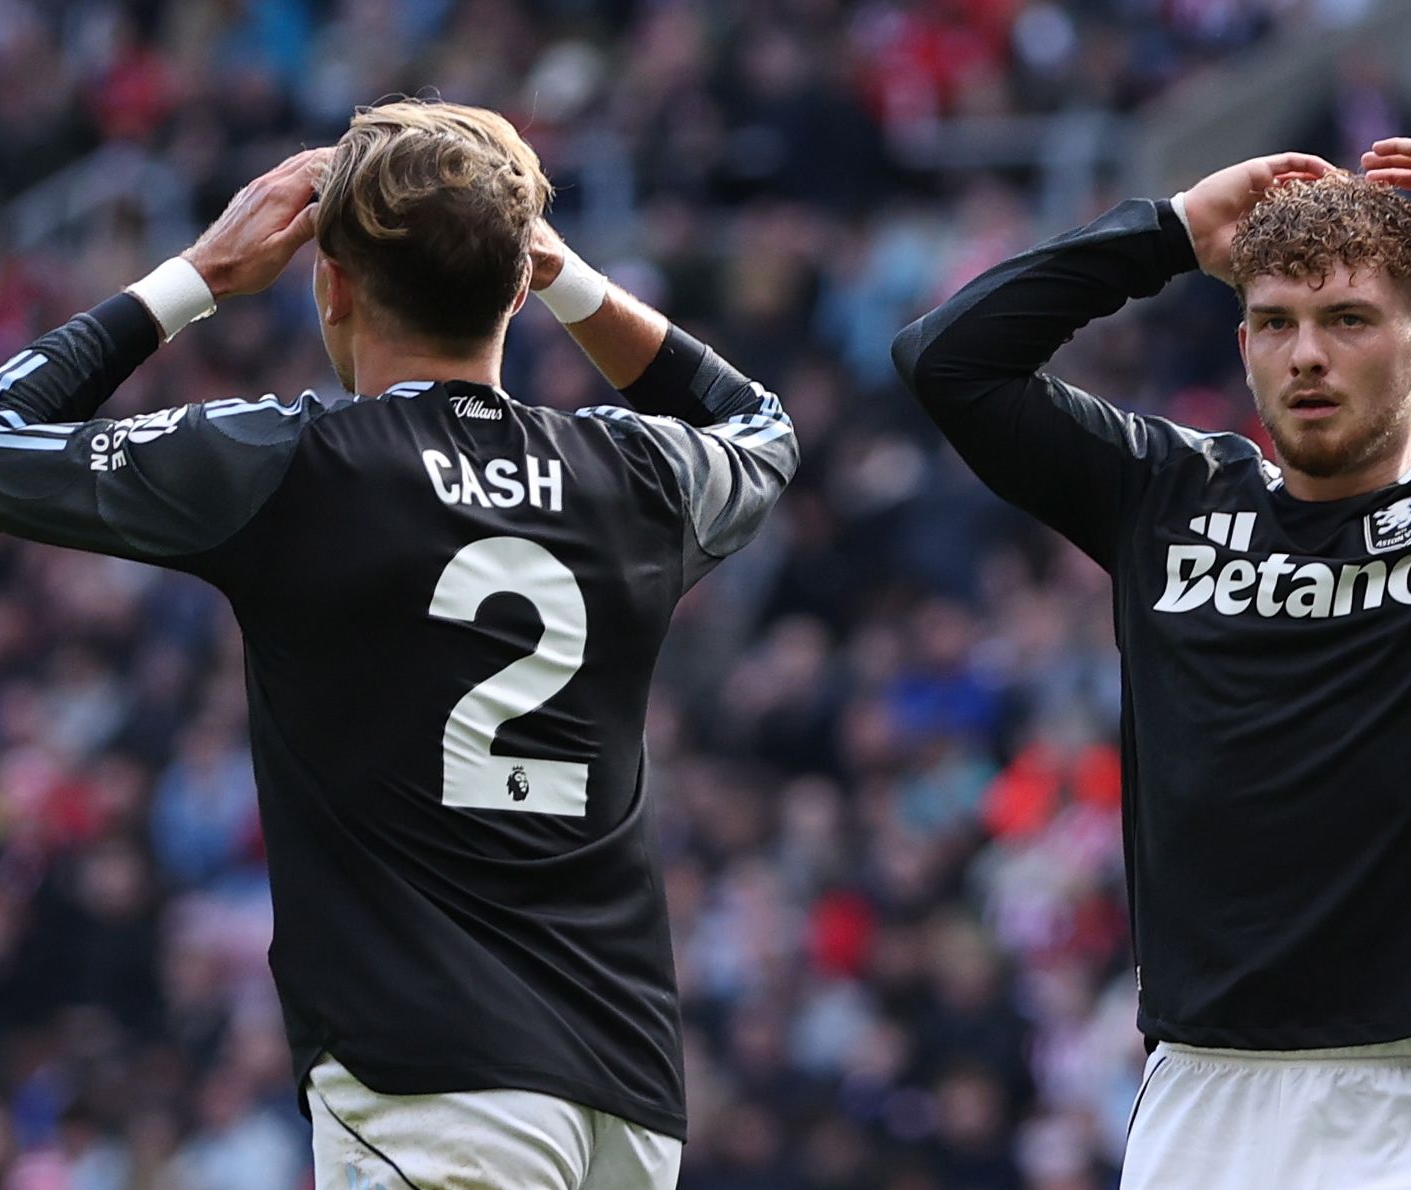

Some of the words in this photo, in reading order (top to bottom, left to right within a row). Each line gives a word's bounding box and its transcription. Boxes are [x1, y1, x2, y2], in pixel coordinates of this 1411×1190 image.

[449, 396, 503, 421] Villans
[422, 449, 562, 512] CASH
[428, 536, 589, 817] 2
